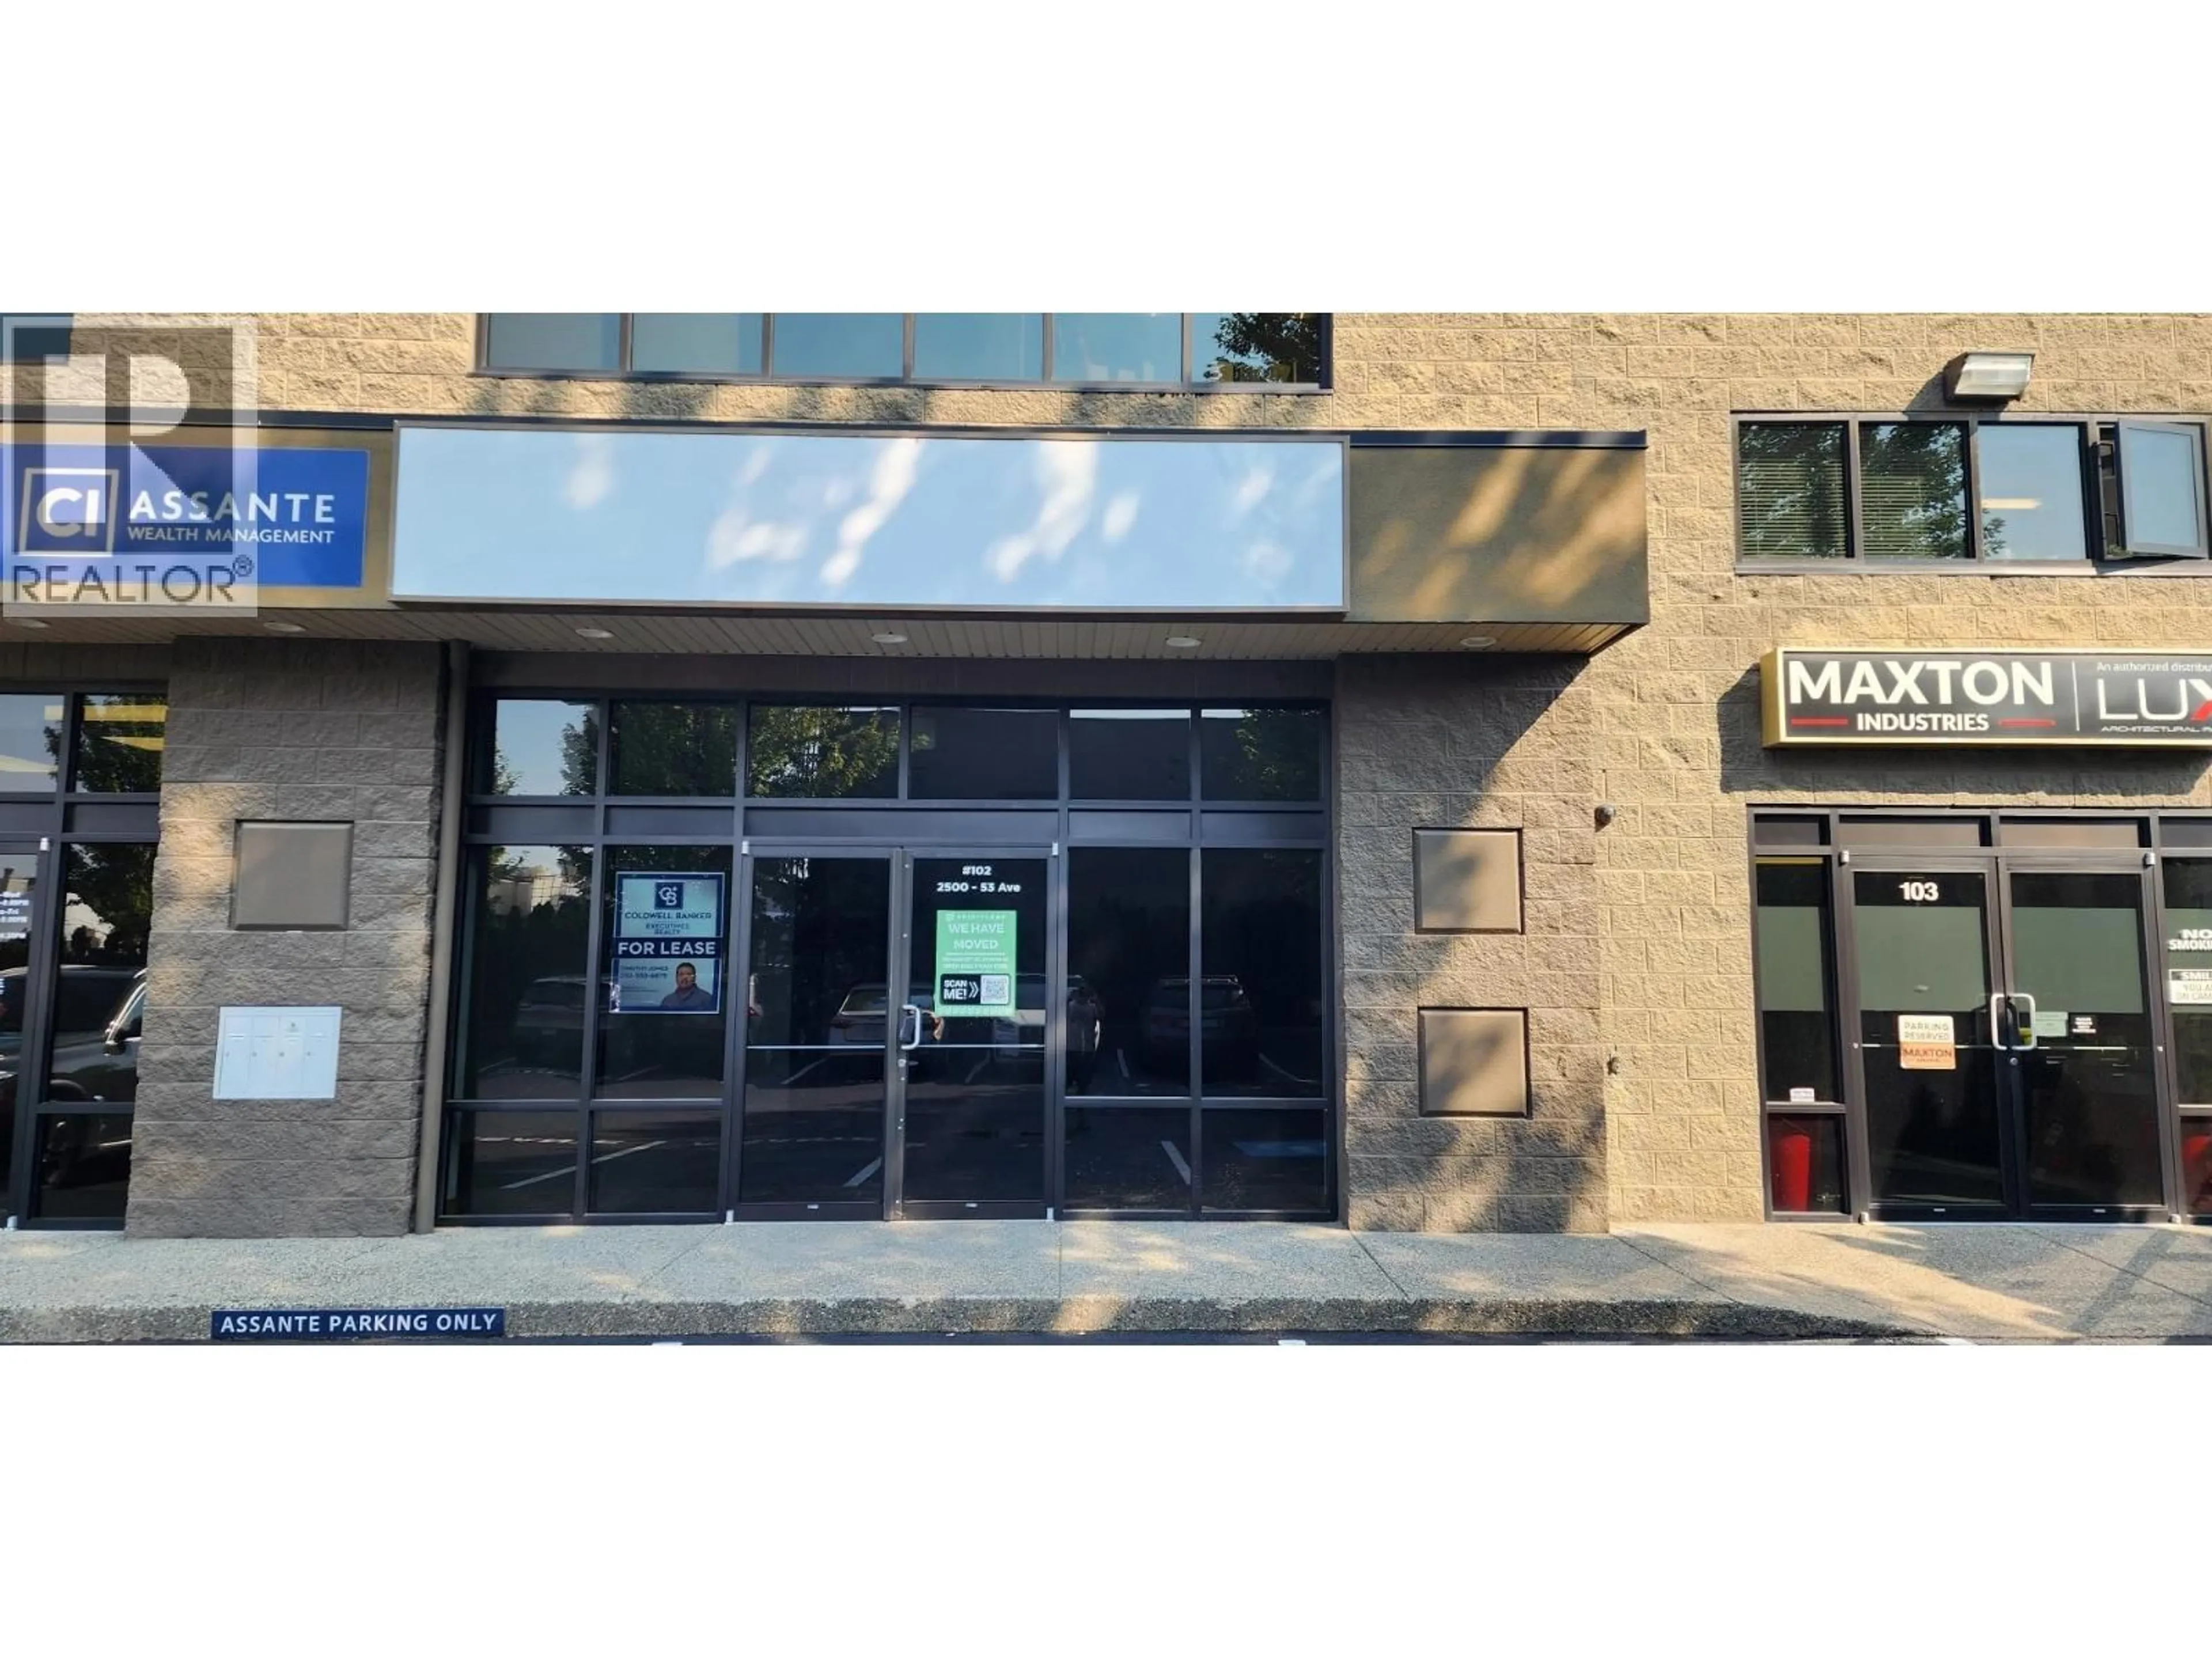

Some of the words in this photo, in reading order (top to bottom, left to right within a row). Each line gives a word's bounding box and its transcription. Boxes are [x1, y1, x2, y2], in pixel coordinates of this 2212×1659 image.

[36, 488, 100, 537] CI
[129, 491, 335, 523] ASSANTE
[128, 526, 198, 541] WEALTH
[206, 528, 334, 543] MANAGEMENT
[2097, 662, 2111, 671] An
[2113, 662, 2169, 672] authorized
[1789, 661, 2054, 705] MAXTON
[1857, 713, 1989, 732] INDUSTRIES
[962, 866, 992, 876] #102
[937, 882, 969, 892] 2500
[980, 882, 995, 892] 53
[998, 882, 1021, 892] Ave
[1899, 882, 1939, 901] 103
[948, 923, 969, 934] WE
[971, 923, 1005, 934] HAVE
[2182, 929, 2212, 939] NO
[618, 941, 655, 955] FOR
[660, 941, 716, 955] LEASE
[953, 940, 999, 950] MOVED
[2168, 939, 2212, 950] SMOKI
[944, 979, 968, 987] SCAN
[944, 988, 967, 1000] ME!
[221, 1316, 320, 1332] ASSANTE
[329, 1314, 427, 1332] PARKING
[436, 1313, 497, 1331] ONLY
